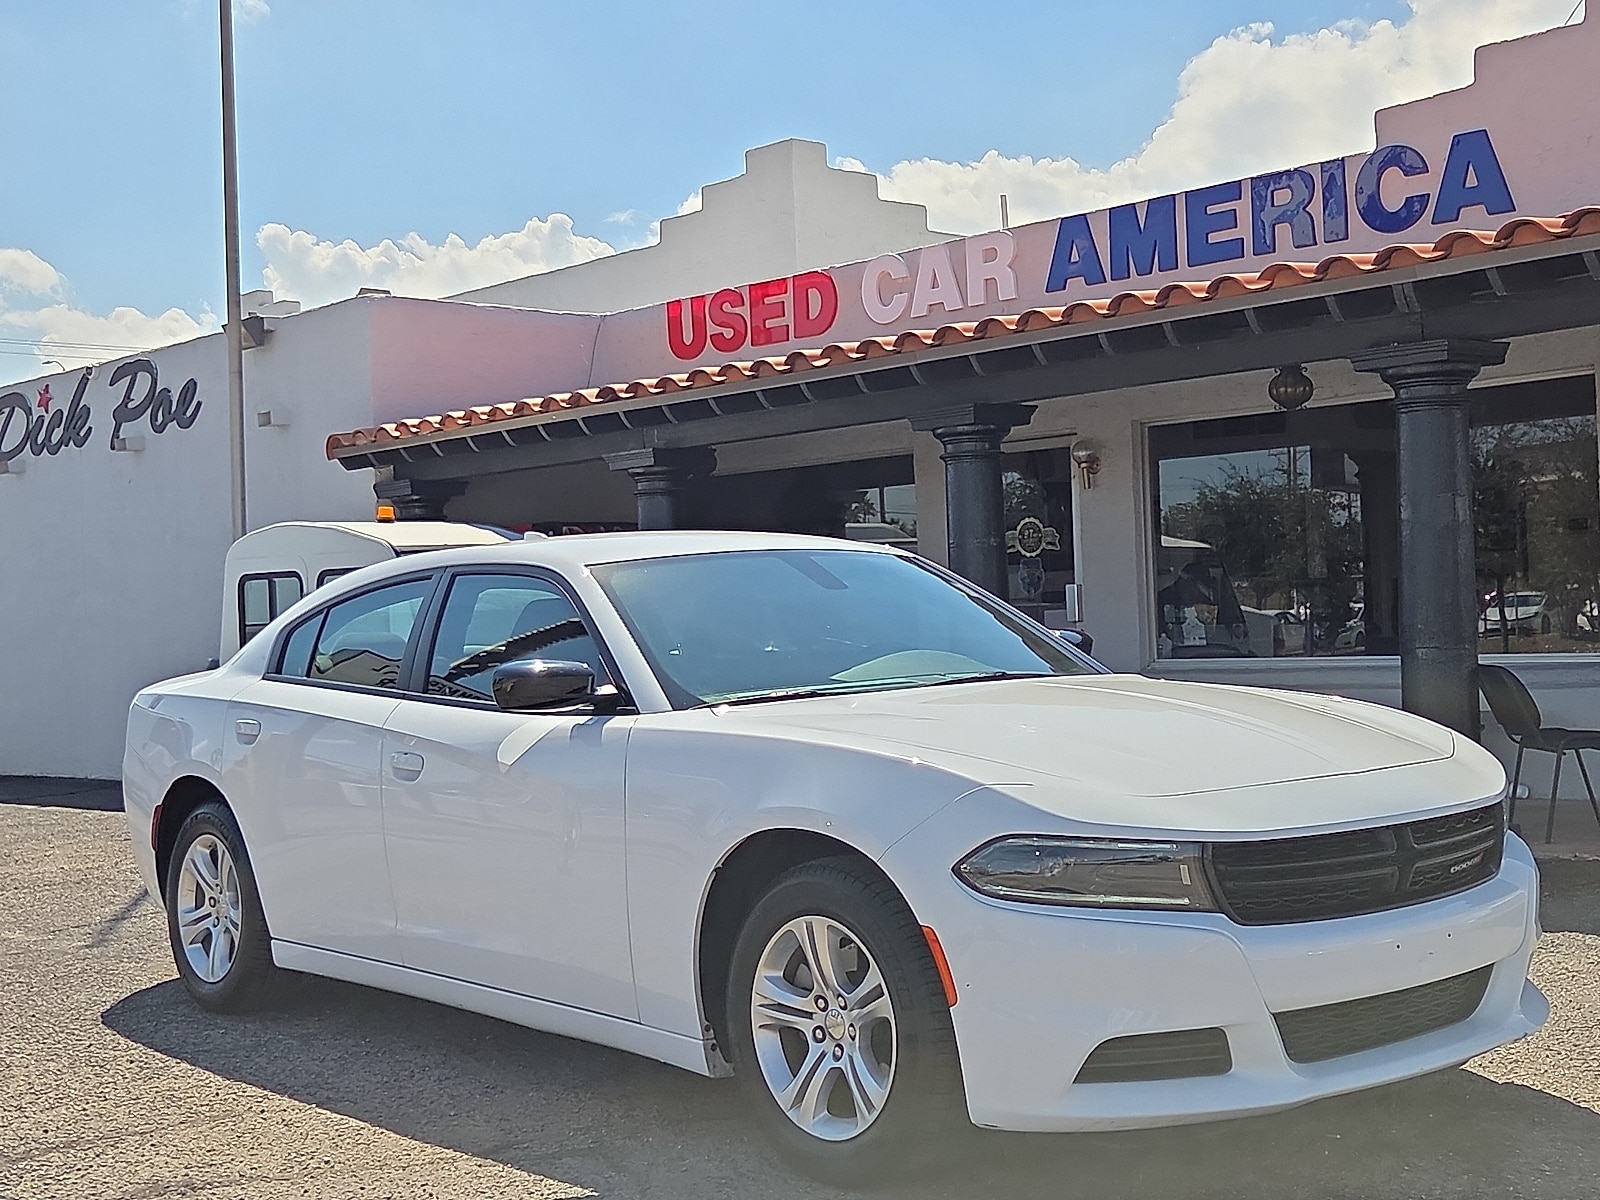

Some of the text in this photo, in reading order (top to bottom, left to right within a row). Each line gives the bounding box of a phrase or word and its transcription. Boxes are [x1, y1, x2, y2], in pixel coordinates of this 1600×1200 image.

[666, 128, 1516, 360] USED CAR AMERICA
[0, 359, 202, 462] Dick Poe
